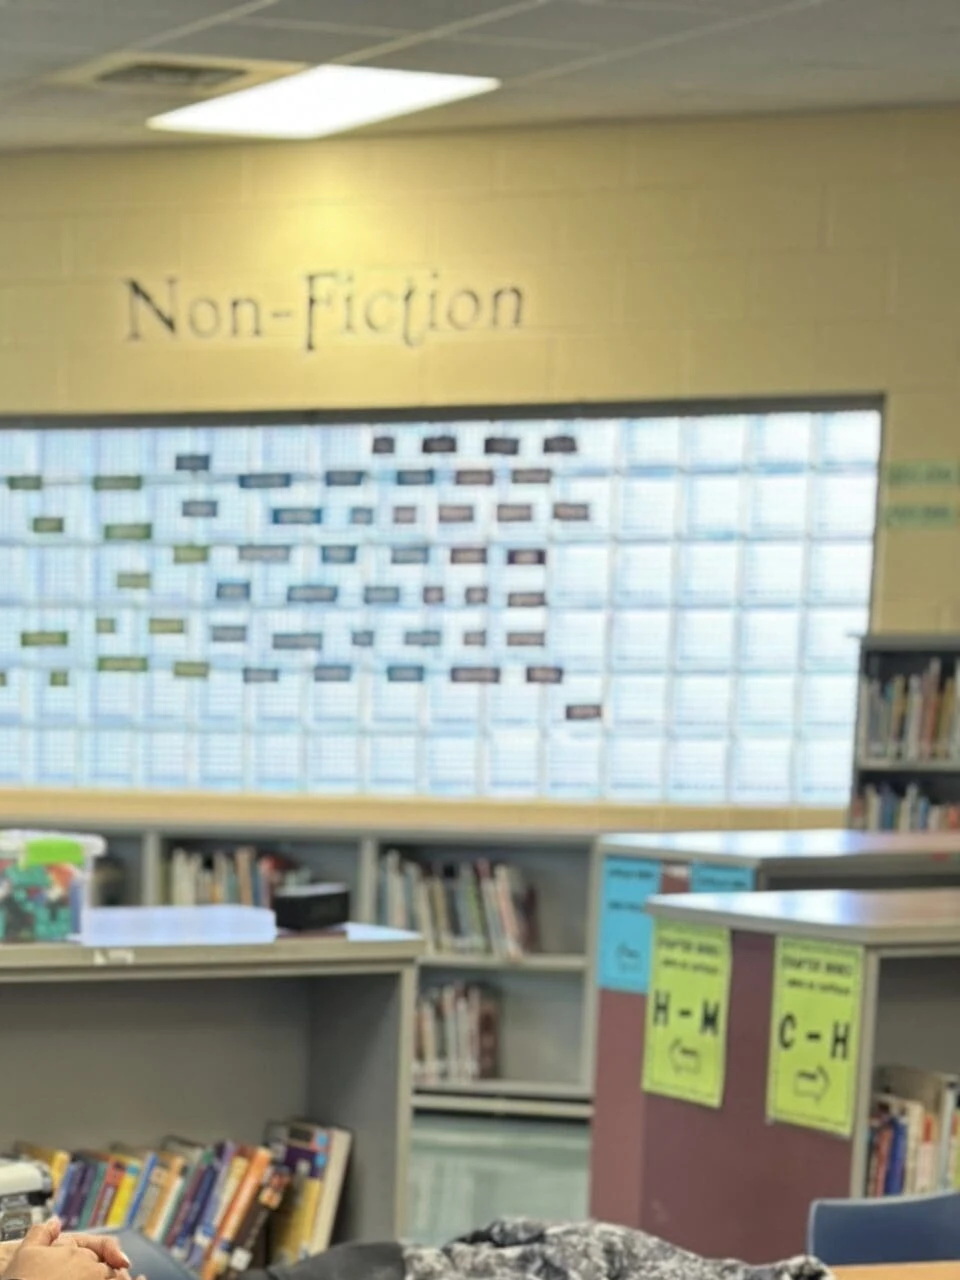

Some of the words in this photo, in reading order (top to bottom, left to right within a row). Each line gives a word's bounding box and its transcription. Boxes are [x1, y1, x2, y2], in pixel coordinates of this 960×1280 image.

[122, 271, 526, 352] Non-Fiction
[652, 989, 671, 1028] H
[779, 1013, 797, 1050] C
[830, 1021, 851, 1060] H
